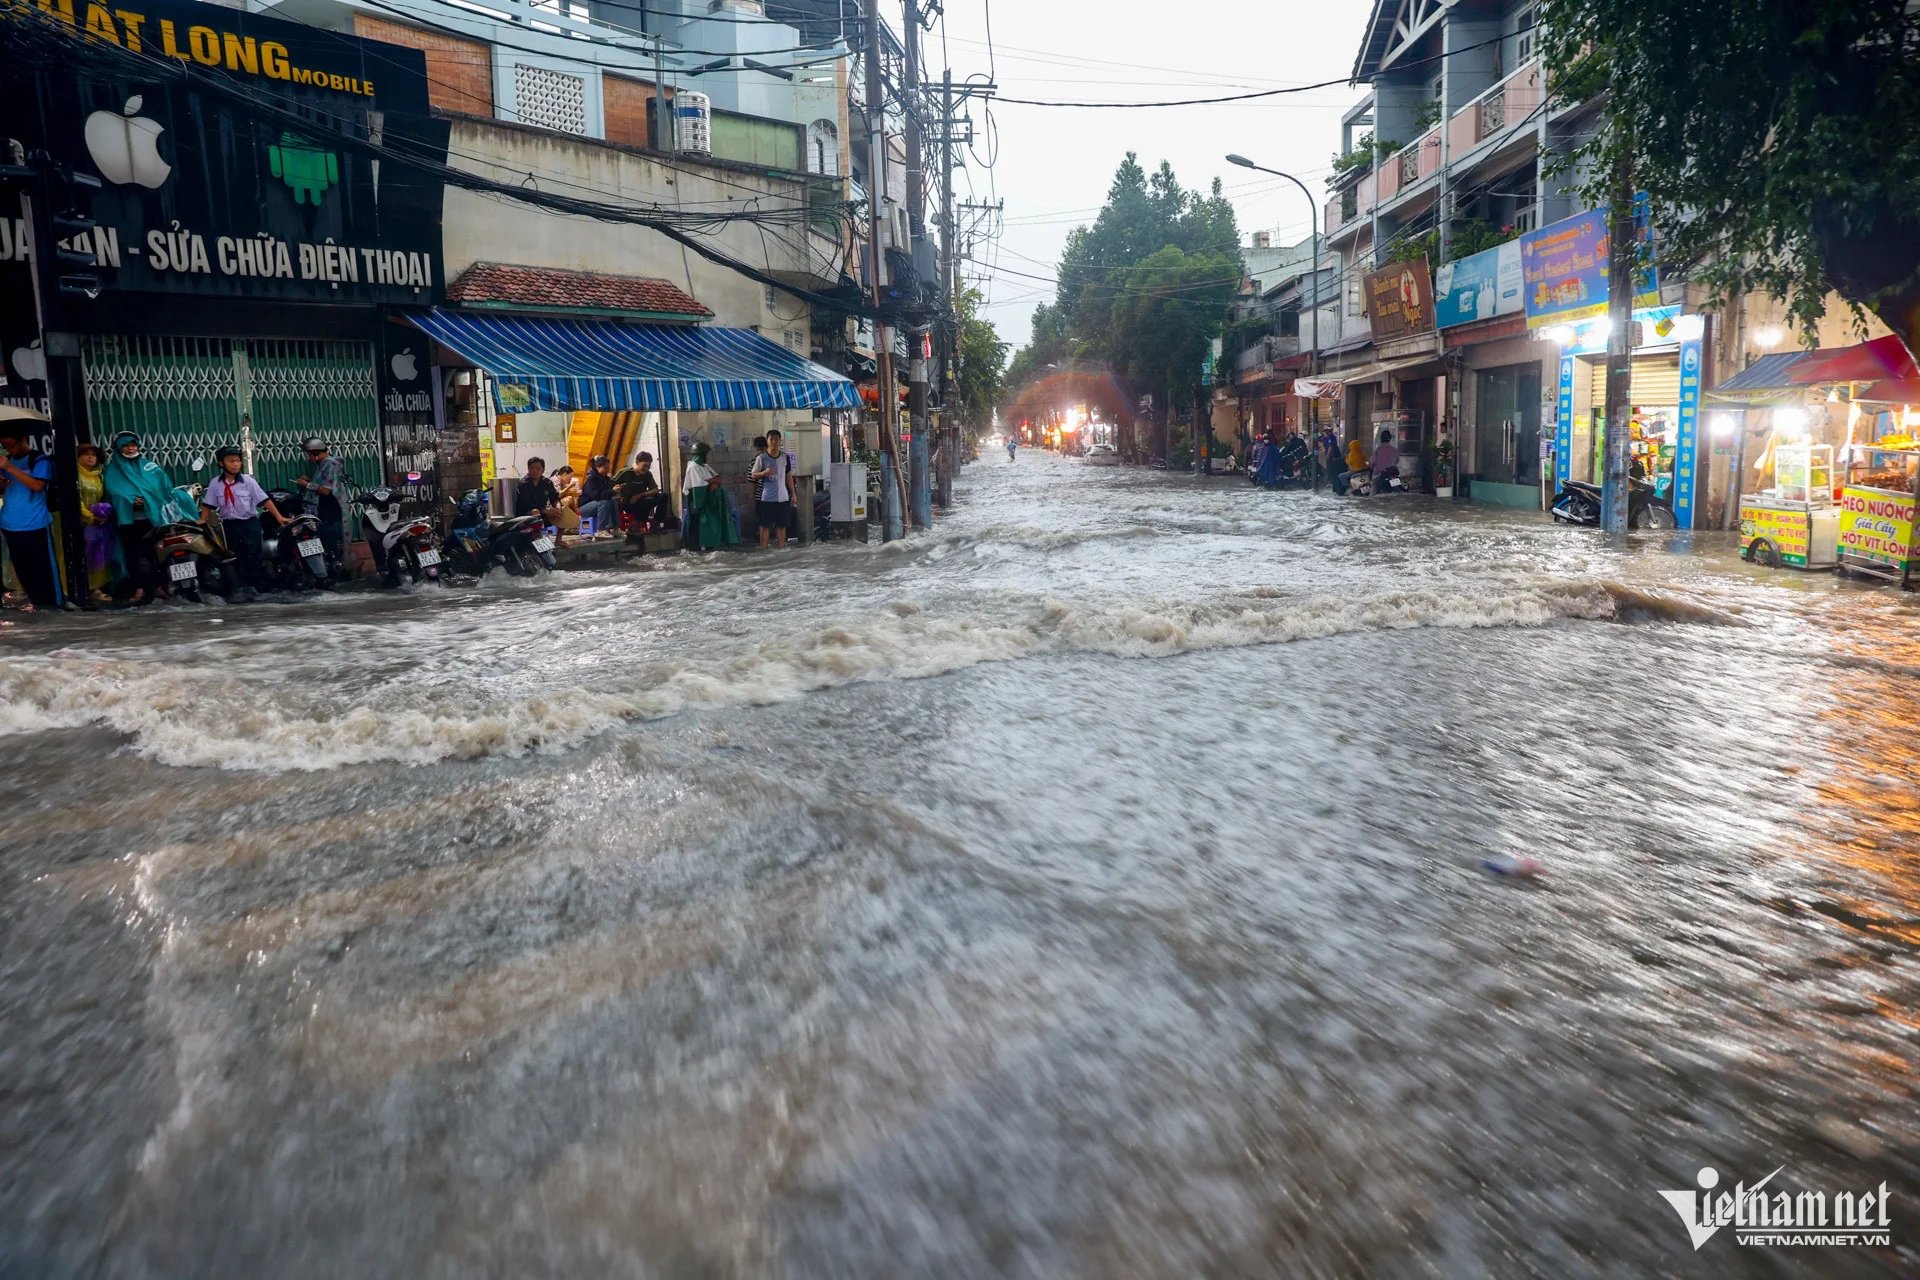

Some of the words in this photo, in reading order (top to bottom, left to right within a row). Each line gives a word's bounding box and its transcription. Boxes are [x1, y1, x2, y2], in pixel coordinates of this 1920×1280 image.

[160, 18, 291, 81] LONG
[292, 66, 375, 97] MOBILE
[147, 219, 212, 274] SỬA
[216, 231, 294, 279] CHỮA
[298, 237, 359, 290] ĐIỆN
[361, 247, 432, 294] THOẠI
[384, 387, 405, 412] SỬA
[405, 389, 432, 412] CHỮA
[1842, 495, 1865, 513] HEO
